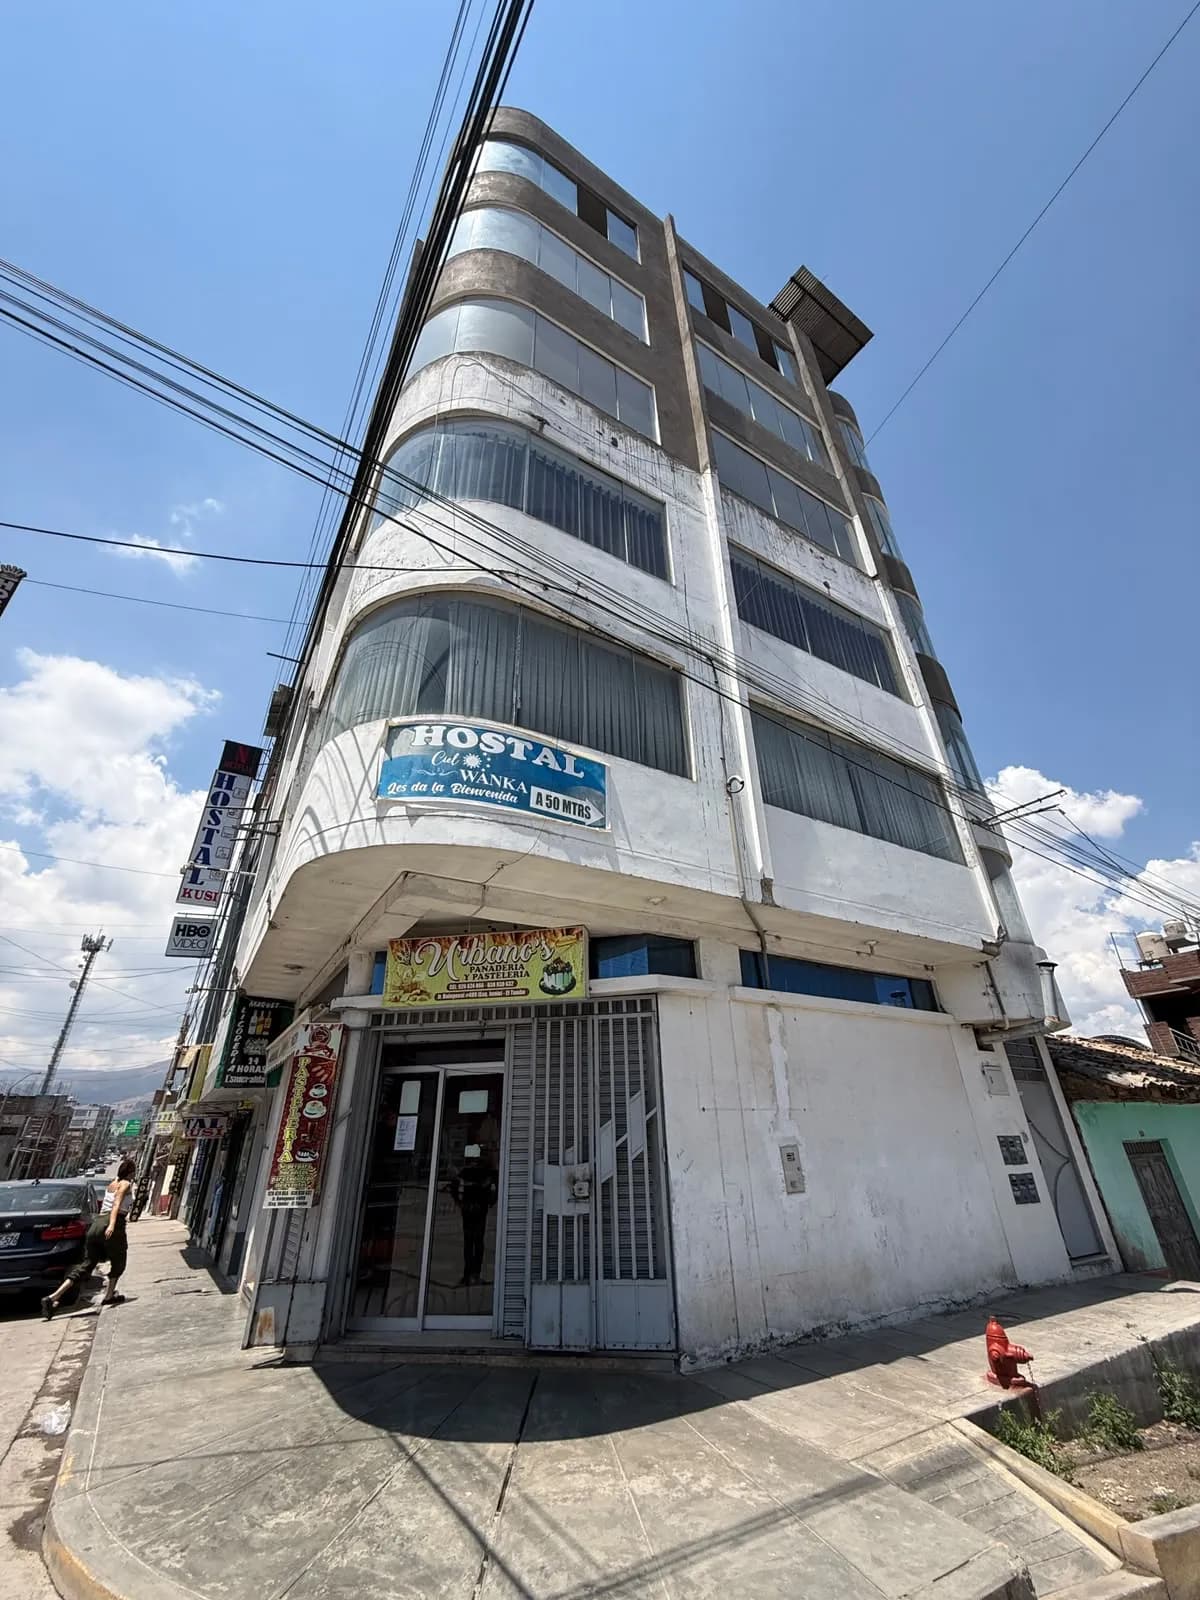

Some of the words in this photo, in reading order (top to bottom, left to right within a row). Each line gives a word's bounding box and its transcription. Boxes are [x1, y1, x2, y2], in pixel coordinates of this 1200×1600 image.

[411, 725, 585, 779] HOSTAL
[411, 781, 427, 792] da
[431, 782, 445, 794] la
[450, 782, 519, 803] Bienvenida
[460, 769, 528, 794] WANKA
[535, 791, 545, 807] A
[543, 794, 560, 811] 50
[561, 797, 592, 820] MTRS
[187, 771, 238, 886] HOSTAL
[180, 887, 221, 902] KUSI
[175, 923, 211, 938] HBO
[172, 937, 208, 950] VIDEO
[414, 938, 556, 982] Urbano's
